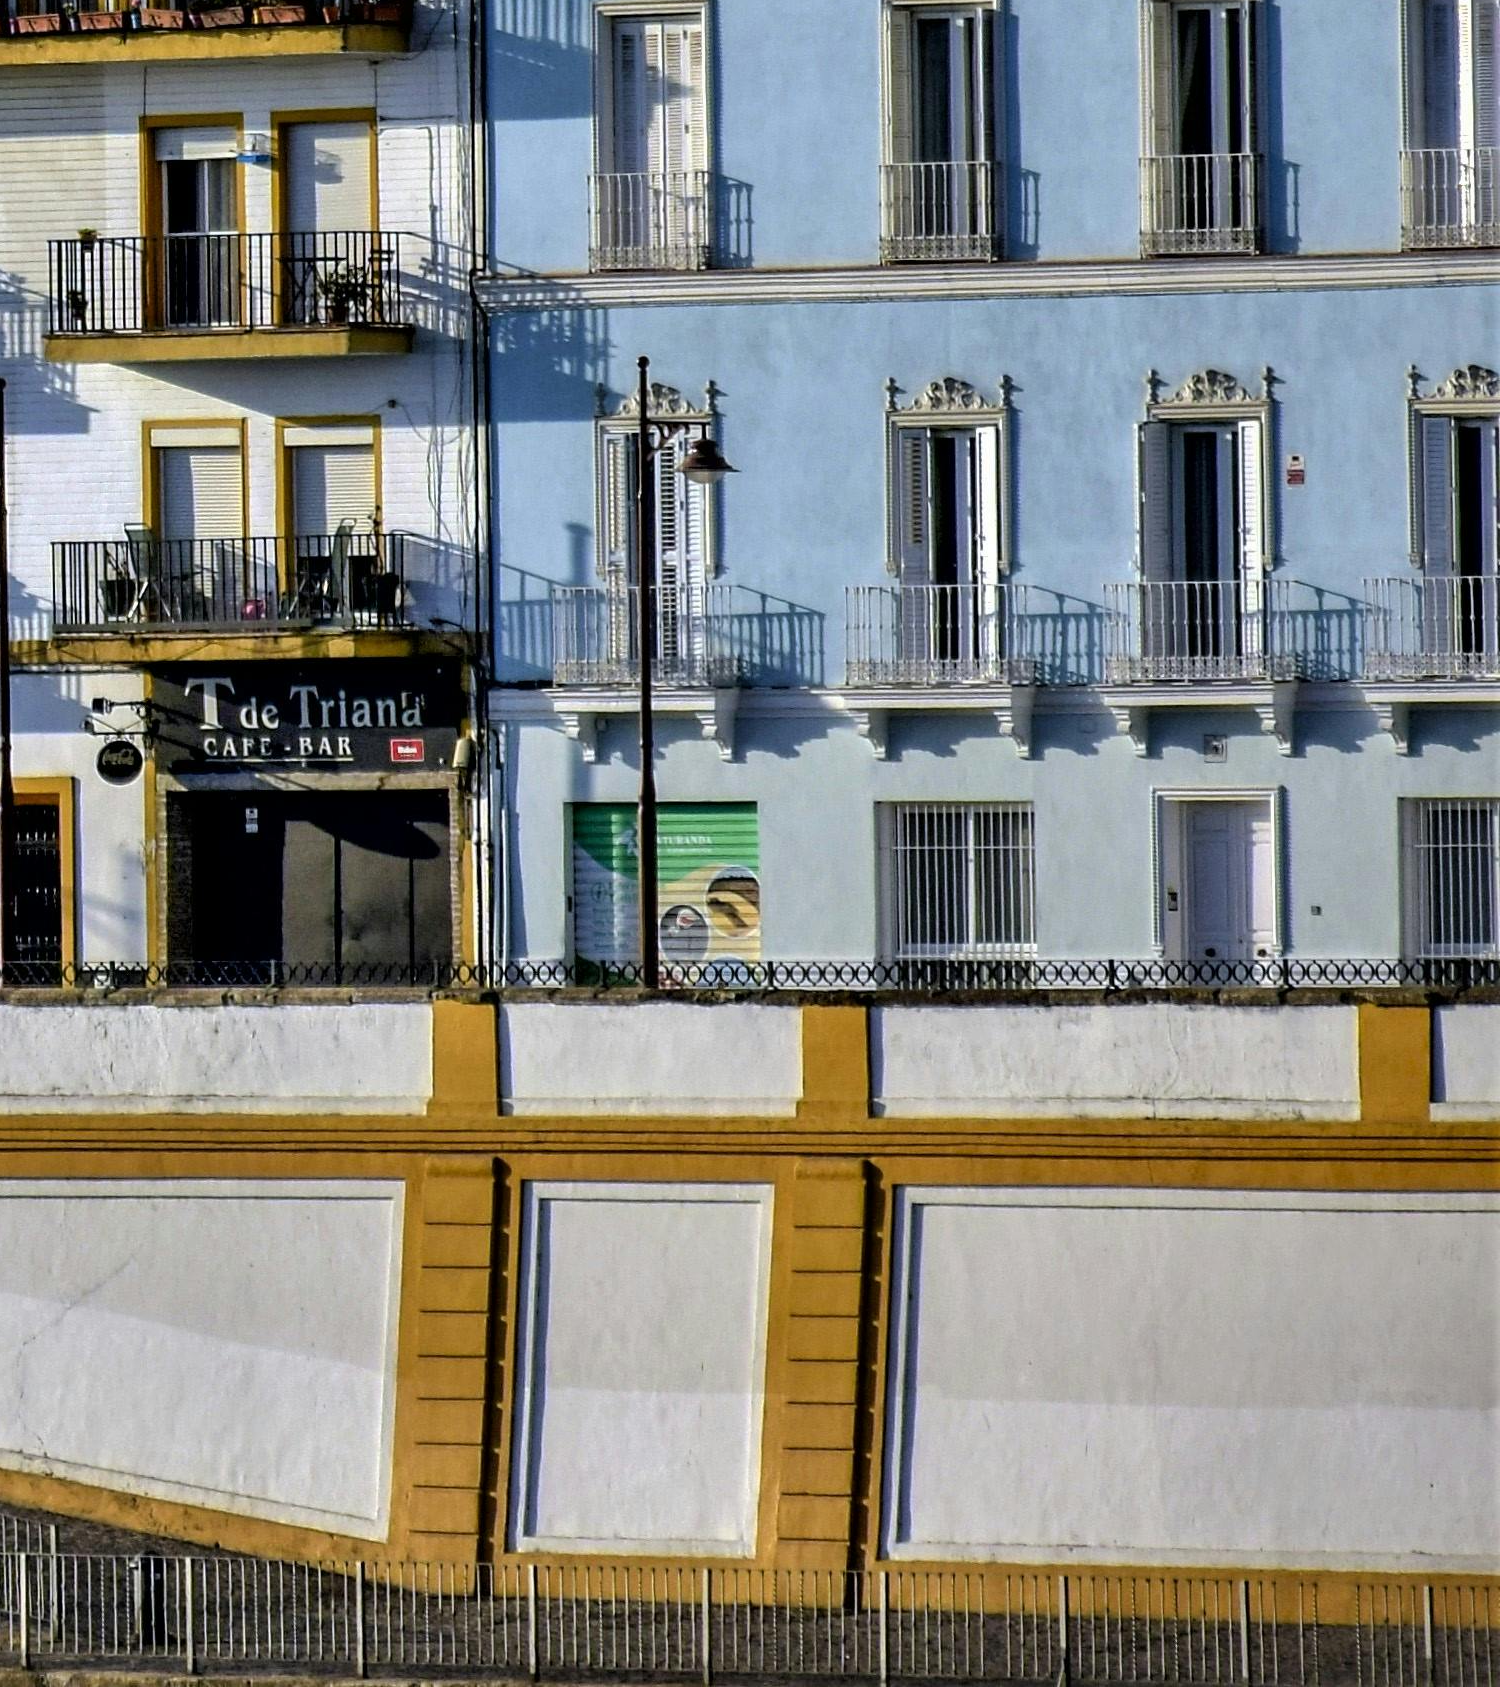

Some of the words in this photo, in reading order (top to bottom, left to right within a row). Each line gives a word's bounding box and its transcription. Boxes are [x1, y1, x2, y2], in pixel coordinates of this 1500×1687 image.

[184, 677, 236, 730] T
[239, 696, 279, 730] de
[289, 685, 423, 728] Triana
[298, 736, 353, 756] BAR
